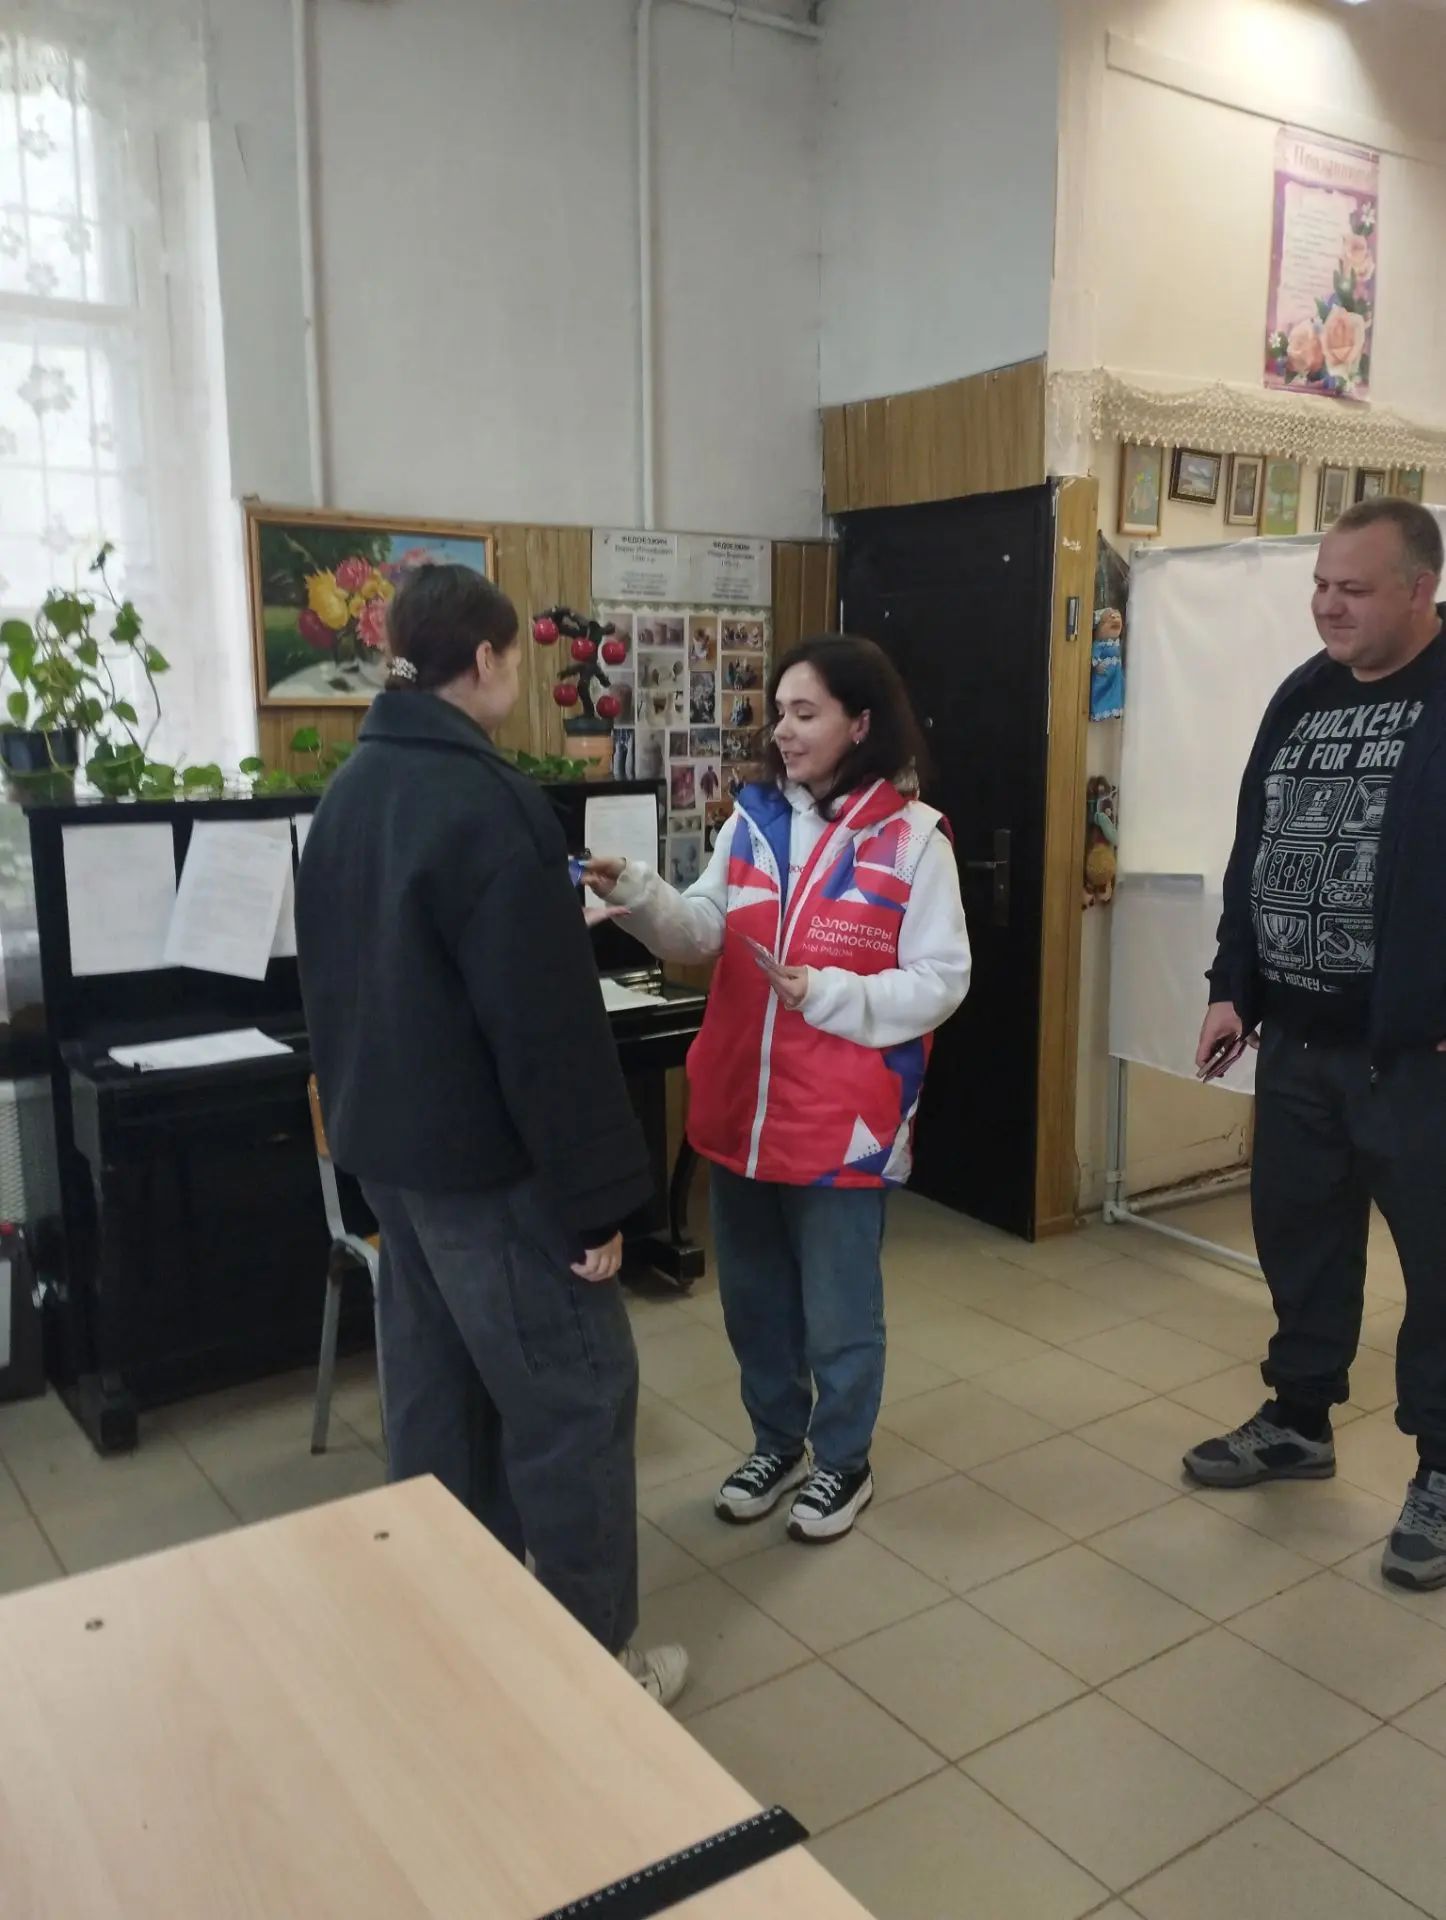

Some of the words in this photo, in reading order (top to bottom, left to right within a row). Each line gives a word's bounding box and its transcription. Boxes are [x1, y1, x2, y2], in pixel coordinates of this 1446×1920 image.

[1302, 700, 1408, 740] HOCKEY
[1307, 743, 1353, 770] FOR
[810, 915, 893, 940] ВОЛОНТЕРЫ
[1284, 971, 1320, 992] HOCKEY
